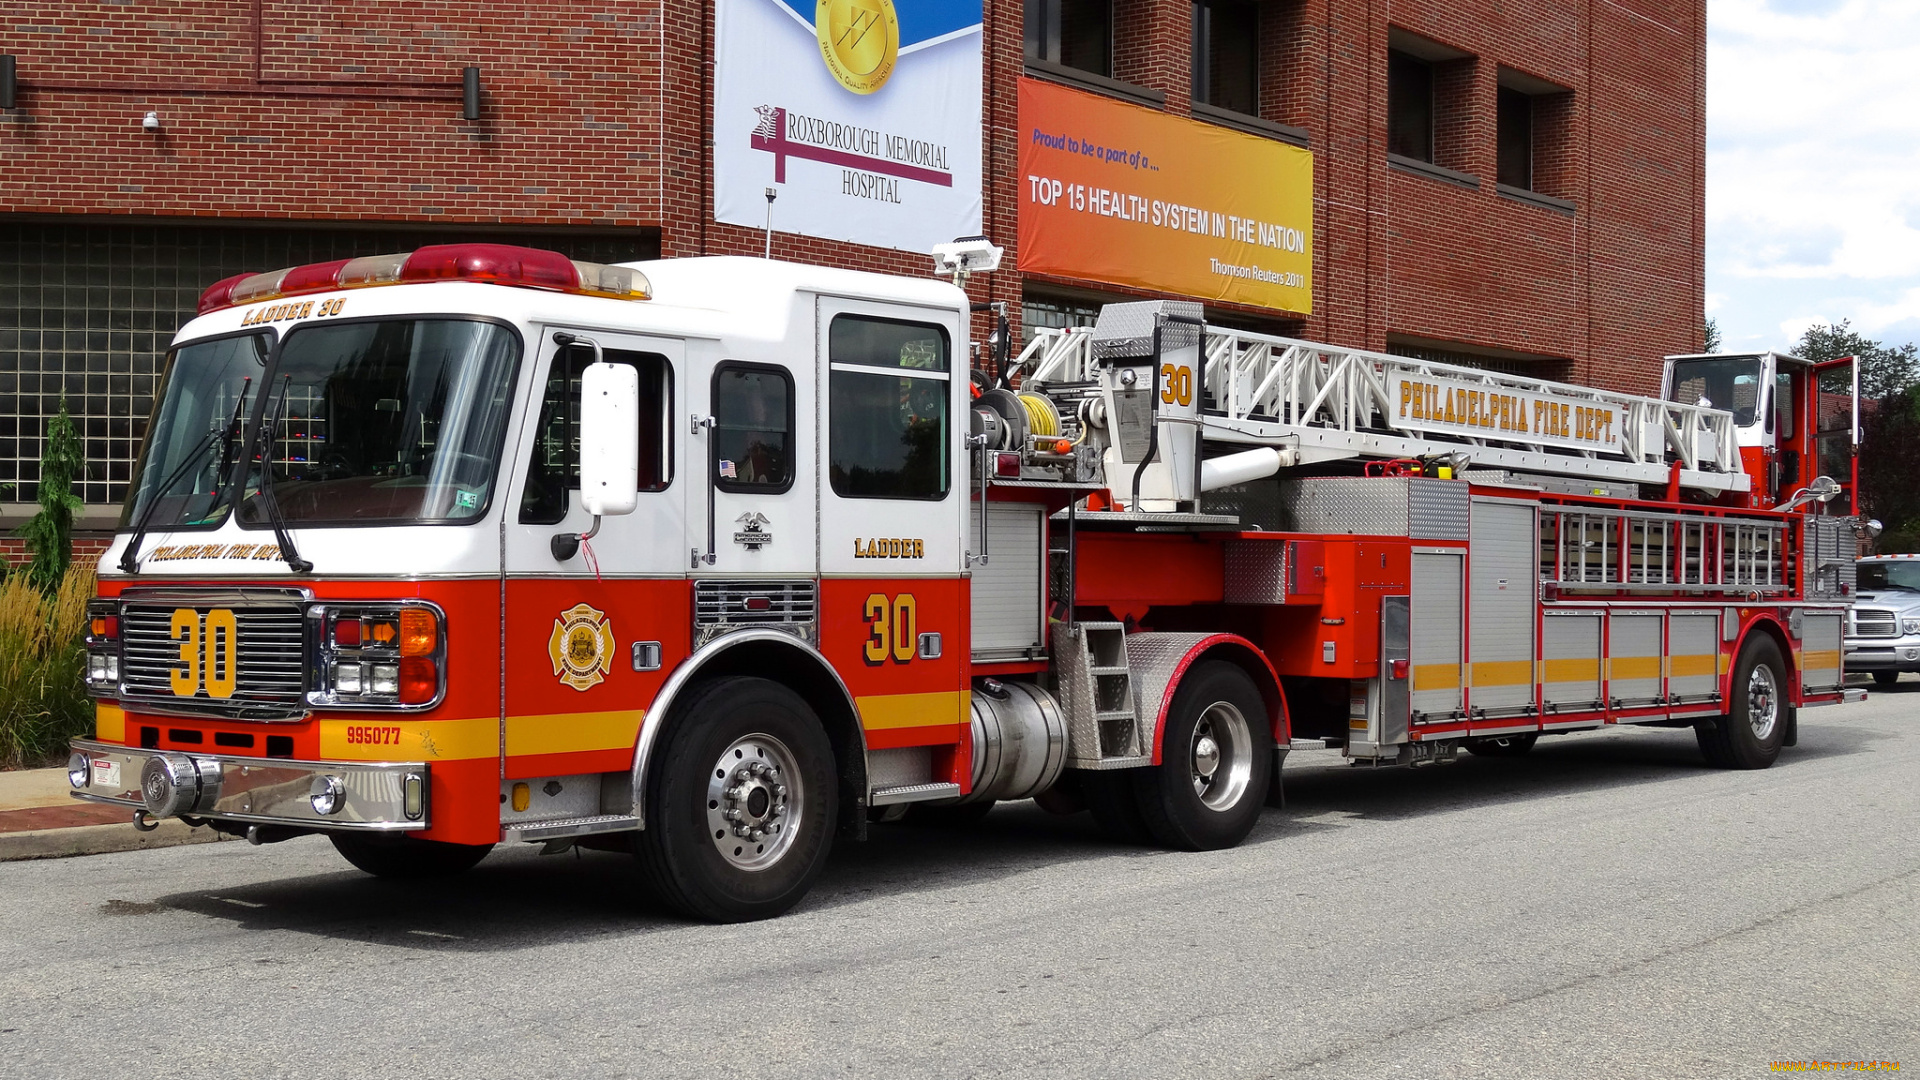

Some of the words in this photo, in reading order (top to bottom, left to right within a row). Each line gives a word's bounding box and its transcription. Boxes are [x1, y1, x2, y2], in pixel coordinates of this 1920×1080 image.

[788, 113, 880, 156] ROXBOROUGH
[885, 133, 950, 170] MEMORIAL
[1033, 128, 1066, 150] Proud
[1068, 137, 1079, 153] to
[1081, 138, 1094, 156] be
[1096, 145, 1103, 158] a
[1105, 148, 1127, 163] part
[1129, 151, 1141, 170] of
[1142, 157, 1148, 168] a
[842, 169, 902, 204] HOSPITAL
[1028, 175, 1063, 206] TOP
[1067, 183, 1086, 212] 15
[1089, 187, 1148, 224] HEALTH
[1152, 200, 1209, 236] SYSTEM
[1212, 212, 1226, 239] IN
[1229, 215, 1255, 244] THE
[1258, 221, 1305, 254] NATION
[1210, 257, 1251, 279] Thomson
[1253, 265, 1284, 285] Reuters
[1285, 272, 1305, 288] 2011
[241, 301, 315, 327] LADDER
[318, 298, 347, 317] 30
[1161, 363, 1192, 406] 30
[1400, 380, 1528, 433] PHILADELPHIA
[1533, 400, 1570, 440] FIRE
[1575, 406, 1616, 444] DEPT.
[149, 543, 229, 563] PHILADELPHIA
[222, 543, 259, 560] FIRE
[855, 538, 925, 559] LADDER
[564, 617, 601, 632] PHILADELPHIA
[863, 593, 916, 667] 30
[171, 608, 237, 698] 30
[572, 657, 603, 676] DEPARTMENT
[347, 726, 401, 745] 995077
